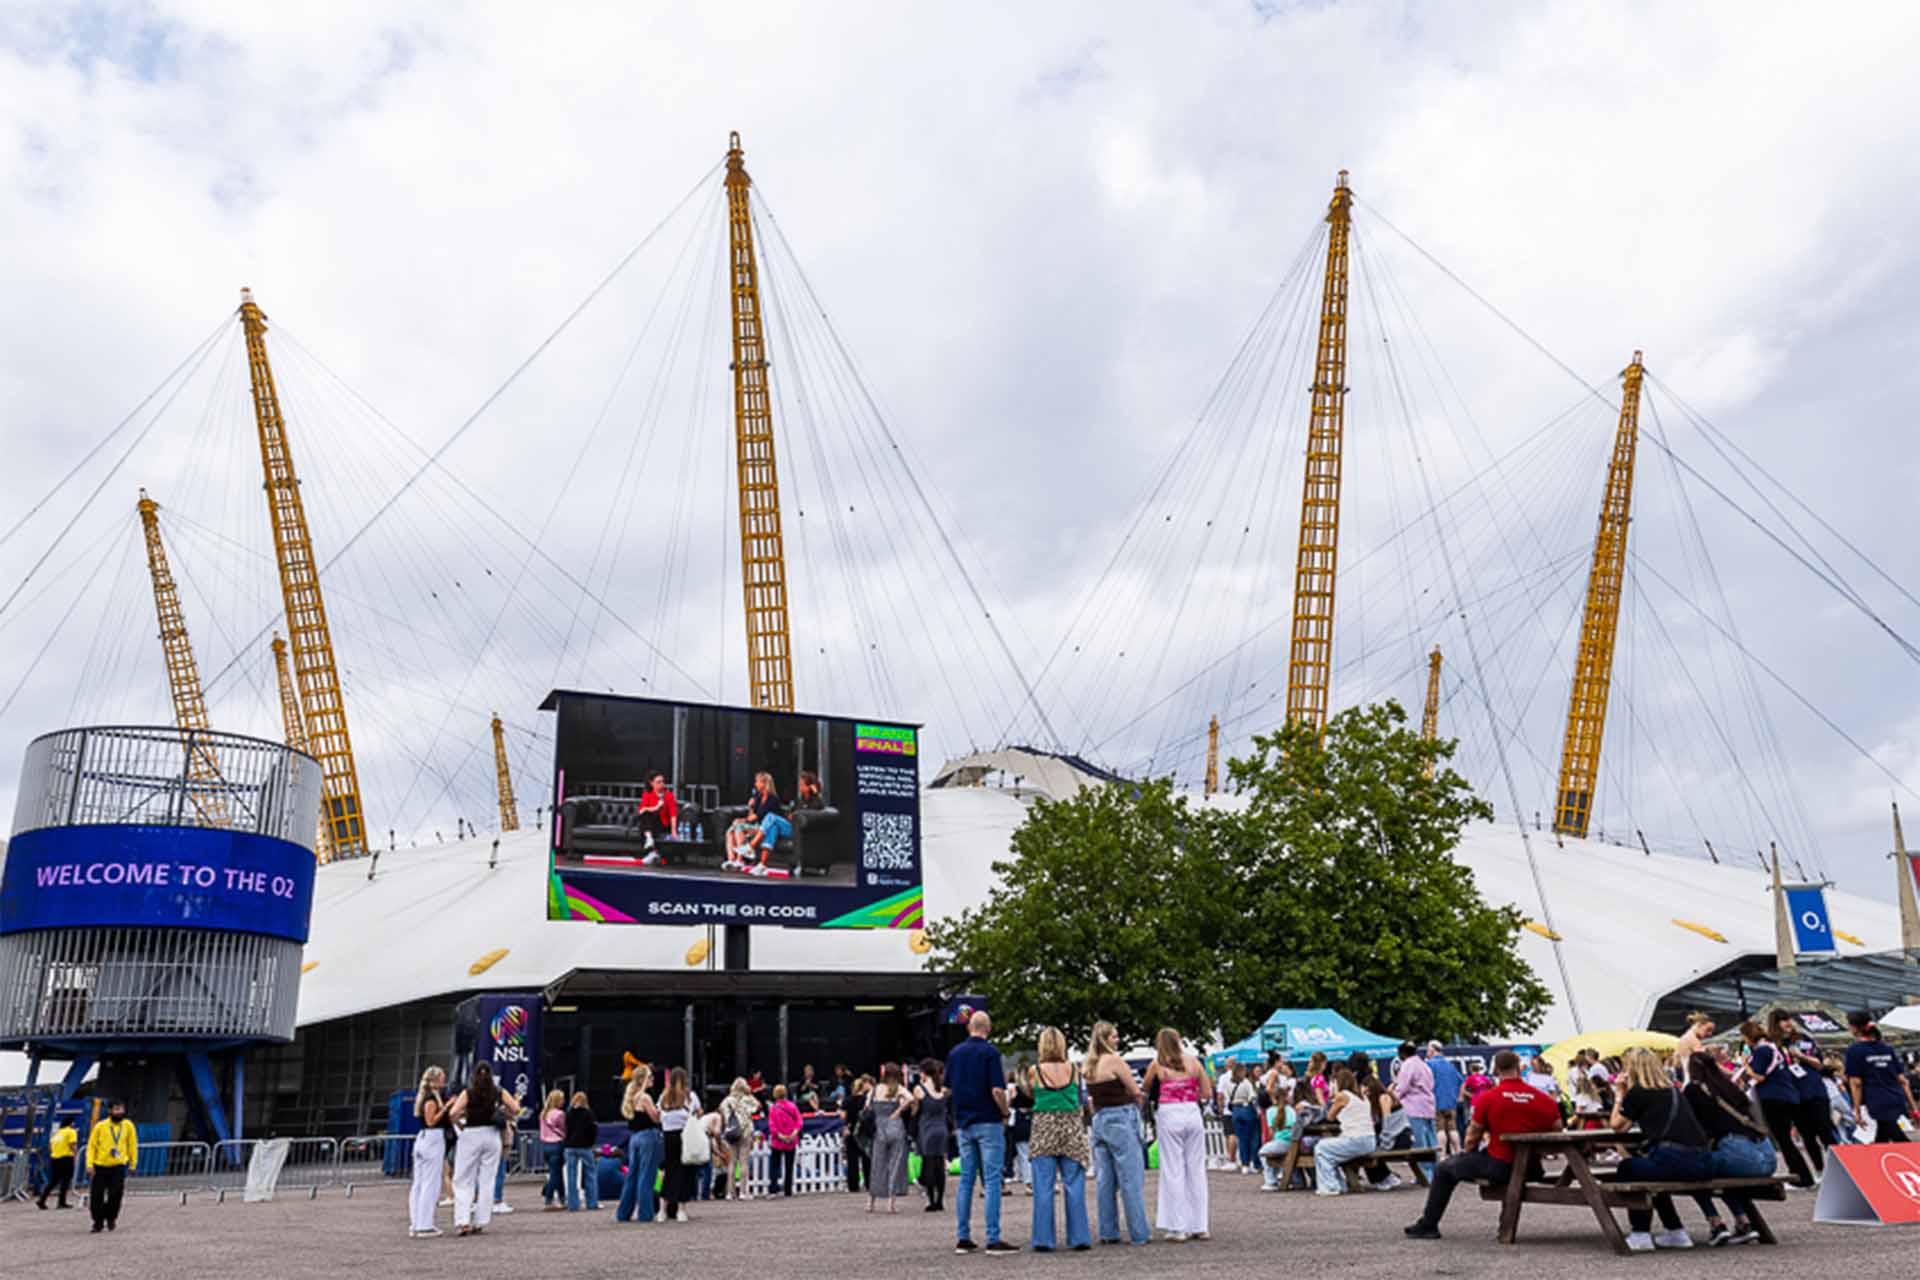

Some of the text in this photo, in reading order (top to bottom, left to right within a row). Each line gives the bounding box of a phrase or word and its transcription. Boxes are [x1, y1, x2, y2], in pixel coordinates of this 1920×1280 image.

[37, 863, 170, 887] WELCOME
[179, 865, 216, 887] TO
[224, 868, 267, 893] THE
[648, 902, 817, 918] SCAN THE QR CODE
[493, 1046, 529, 1061] NSL
